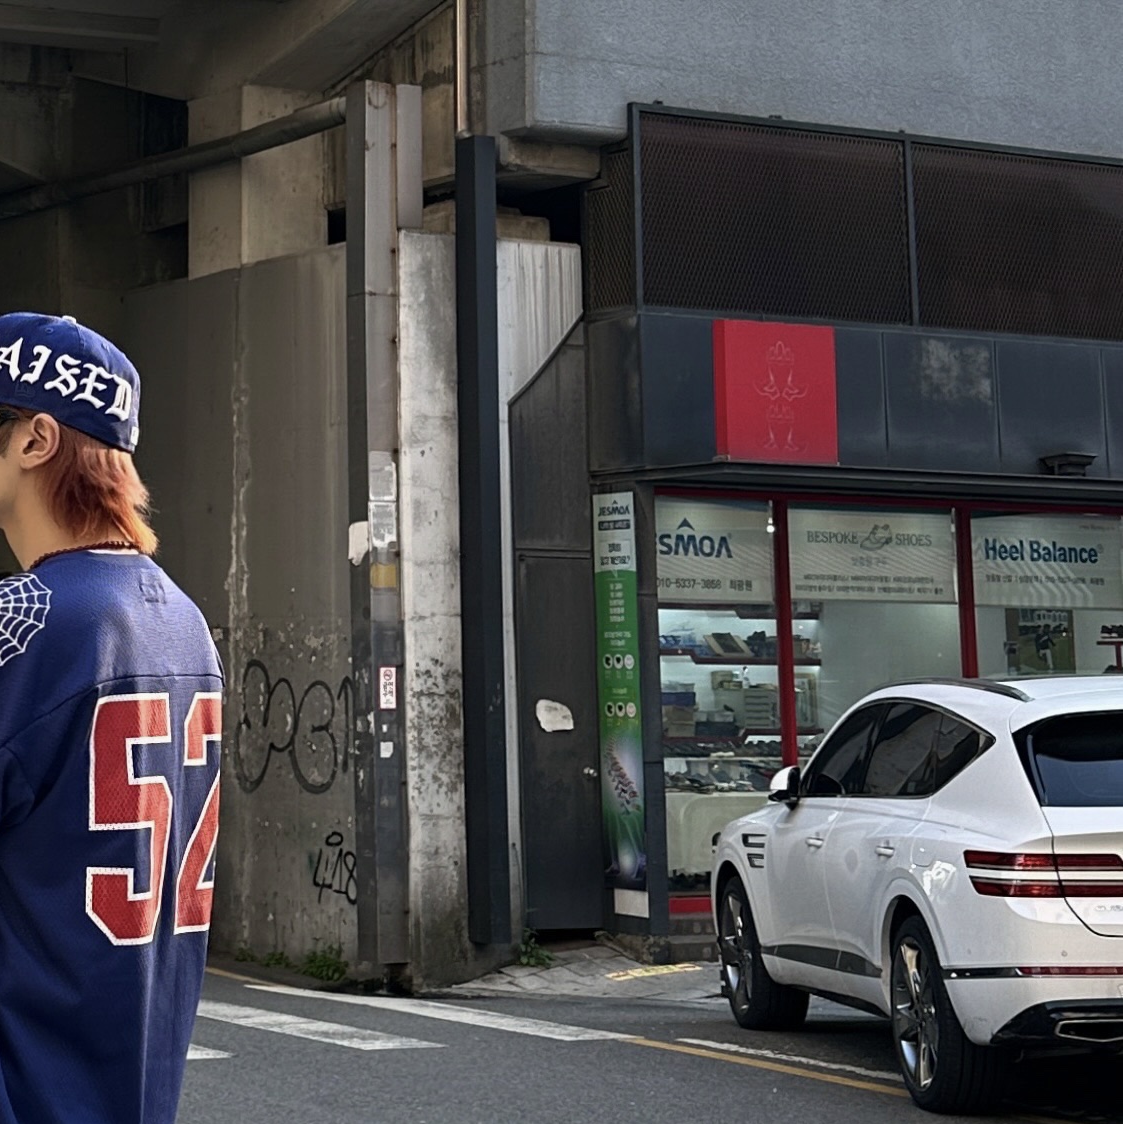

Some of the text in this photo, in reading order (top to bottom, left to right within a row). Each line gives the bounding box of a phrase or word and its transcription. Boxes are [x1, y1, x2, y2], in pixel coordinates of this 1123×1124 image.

[655, 533, 733, 558] SMOA
[806, 530, 932, 547] BESPOKE SHOES
[984, 538, 1099, 564] Heel Balance
[85, 692, 222, 947] 52
